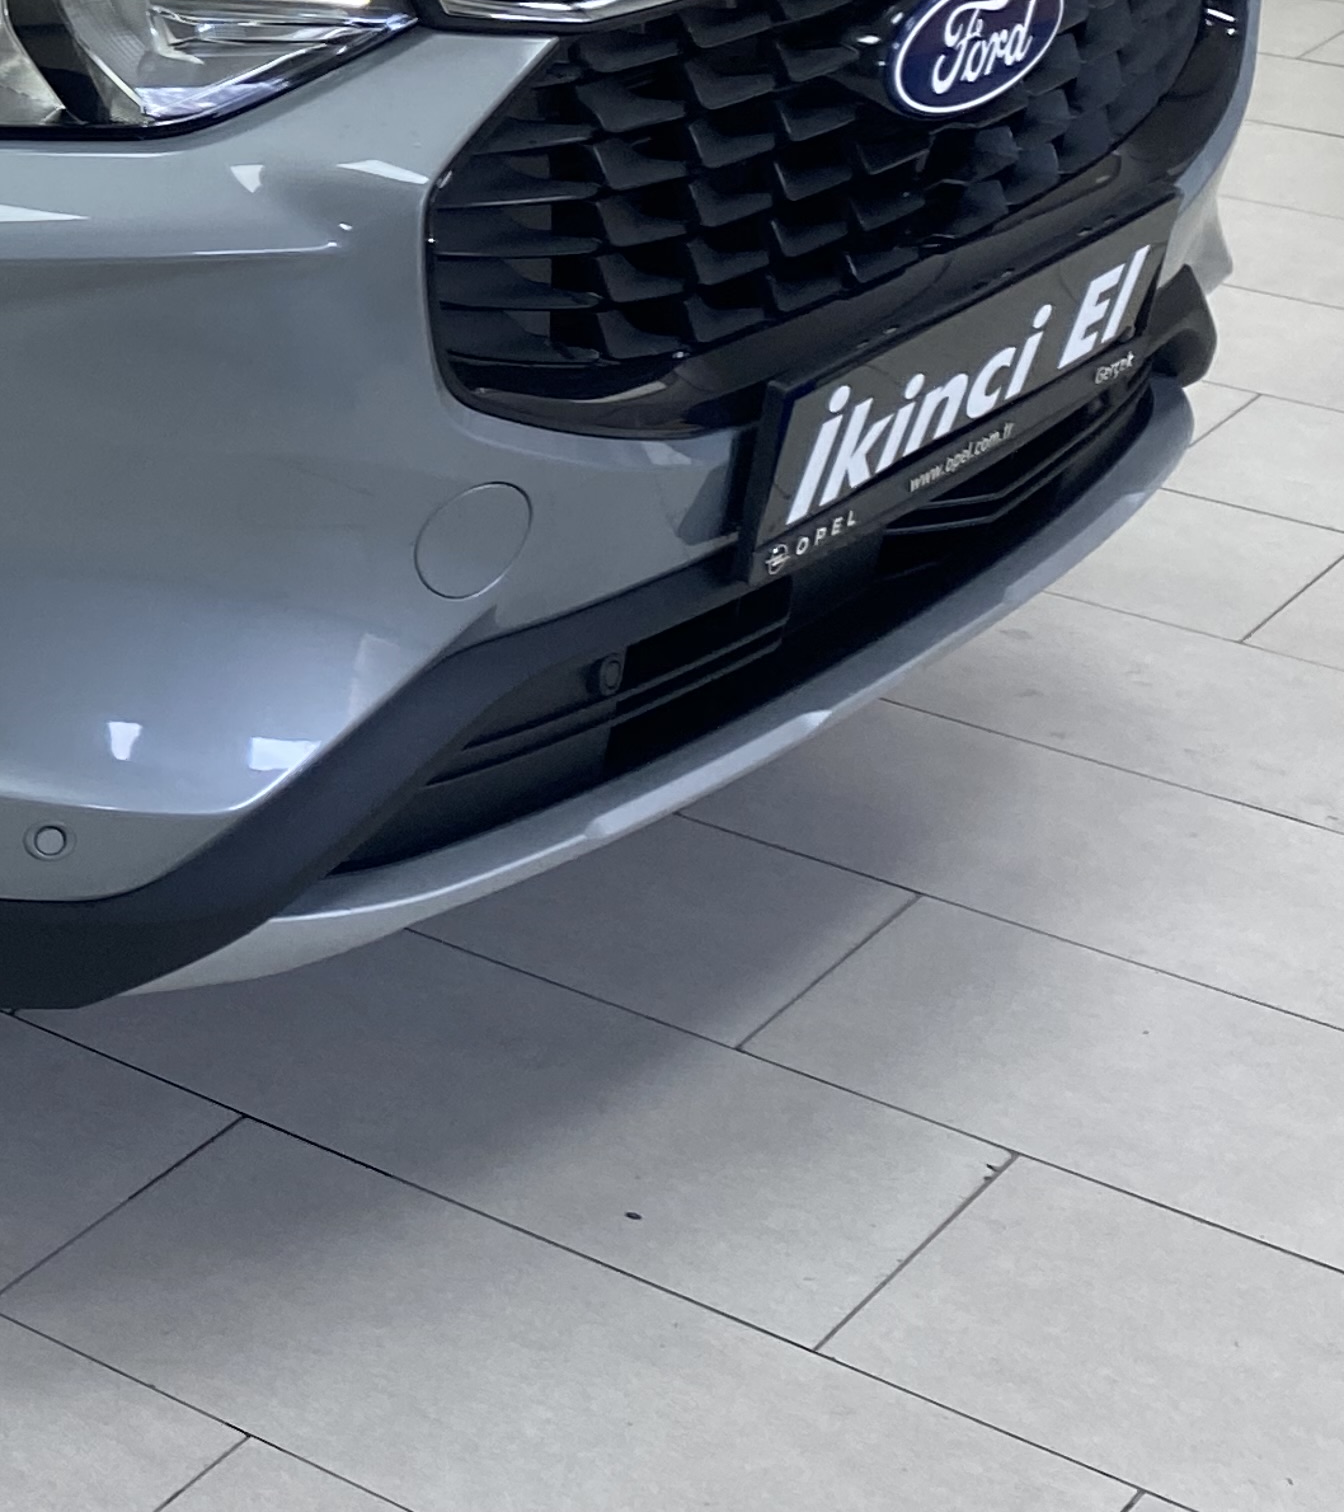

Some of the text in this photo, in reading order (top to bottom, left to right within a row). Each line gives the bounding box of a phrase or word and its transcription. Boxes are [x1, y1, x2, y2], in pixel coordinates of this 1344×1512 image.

[786, 244, 1151, 525] İkinci El
[909, 422, 1014, 493] www.opel.com.tr
[795, 510, 856, 555] OPEL
